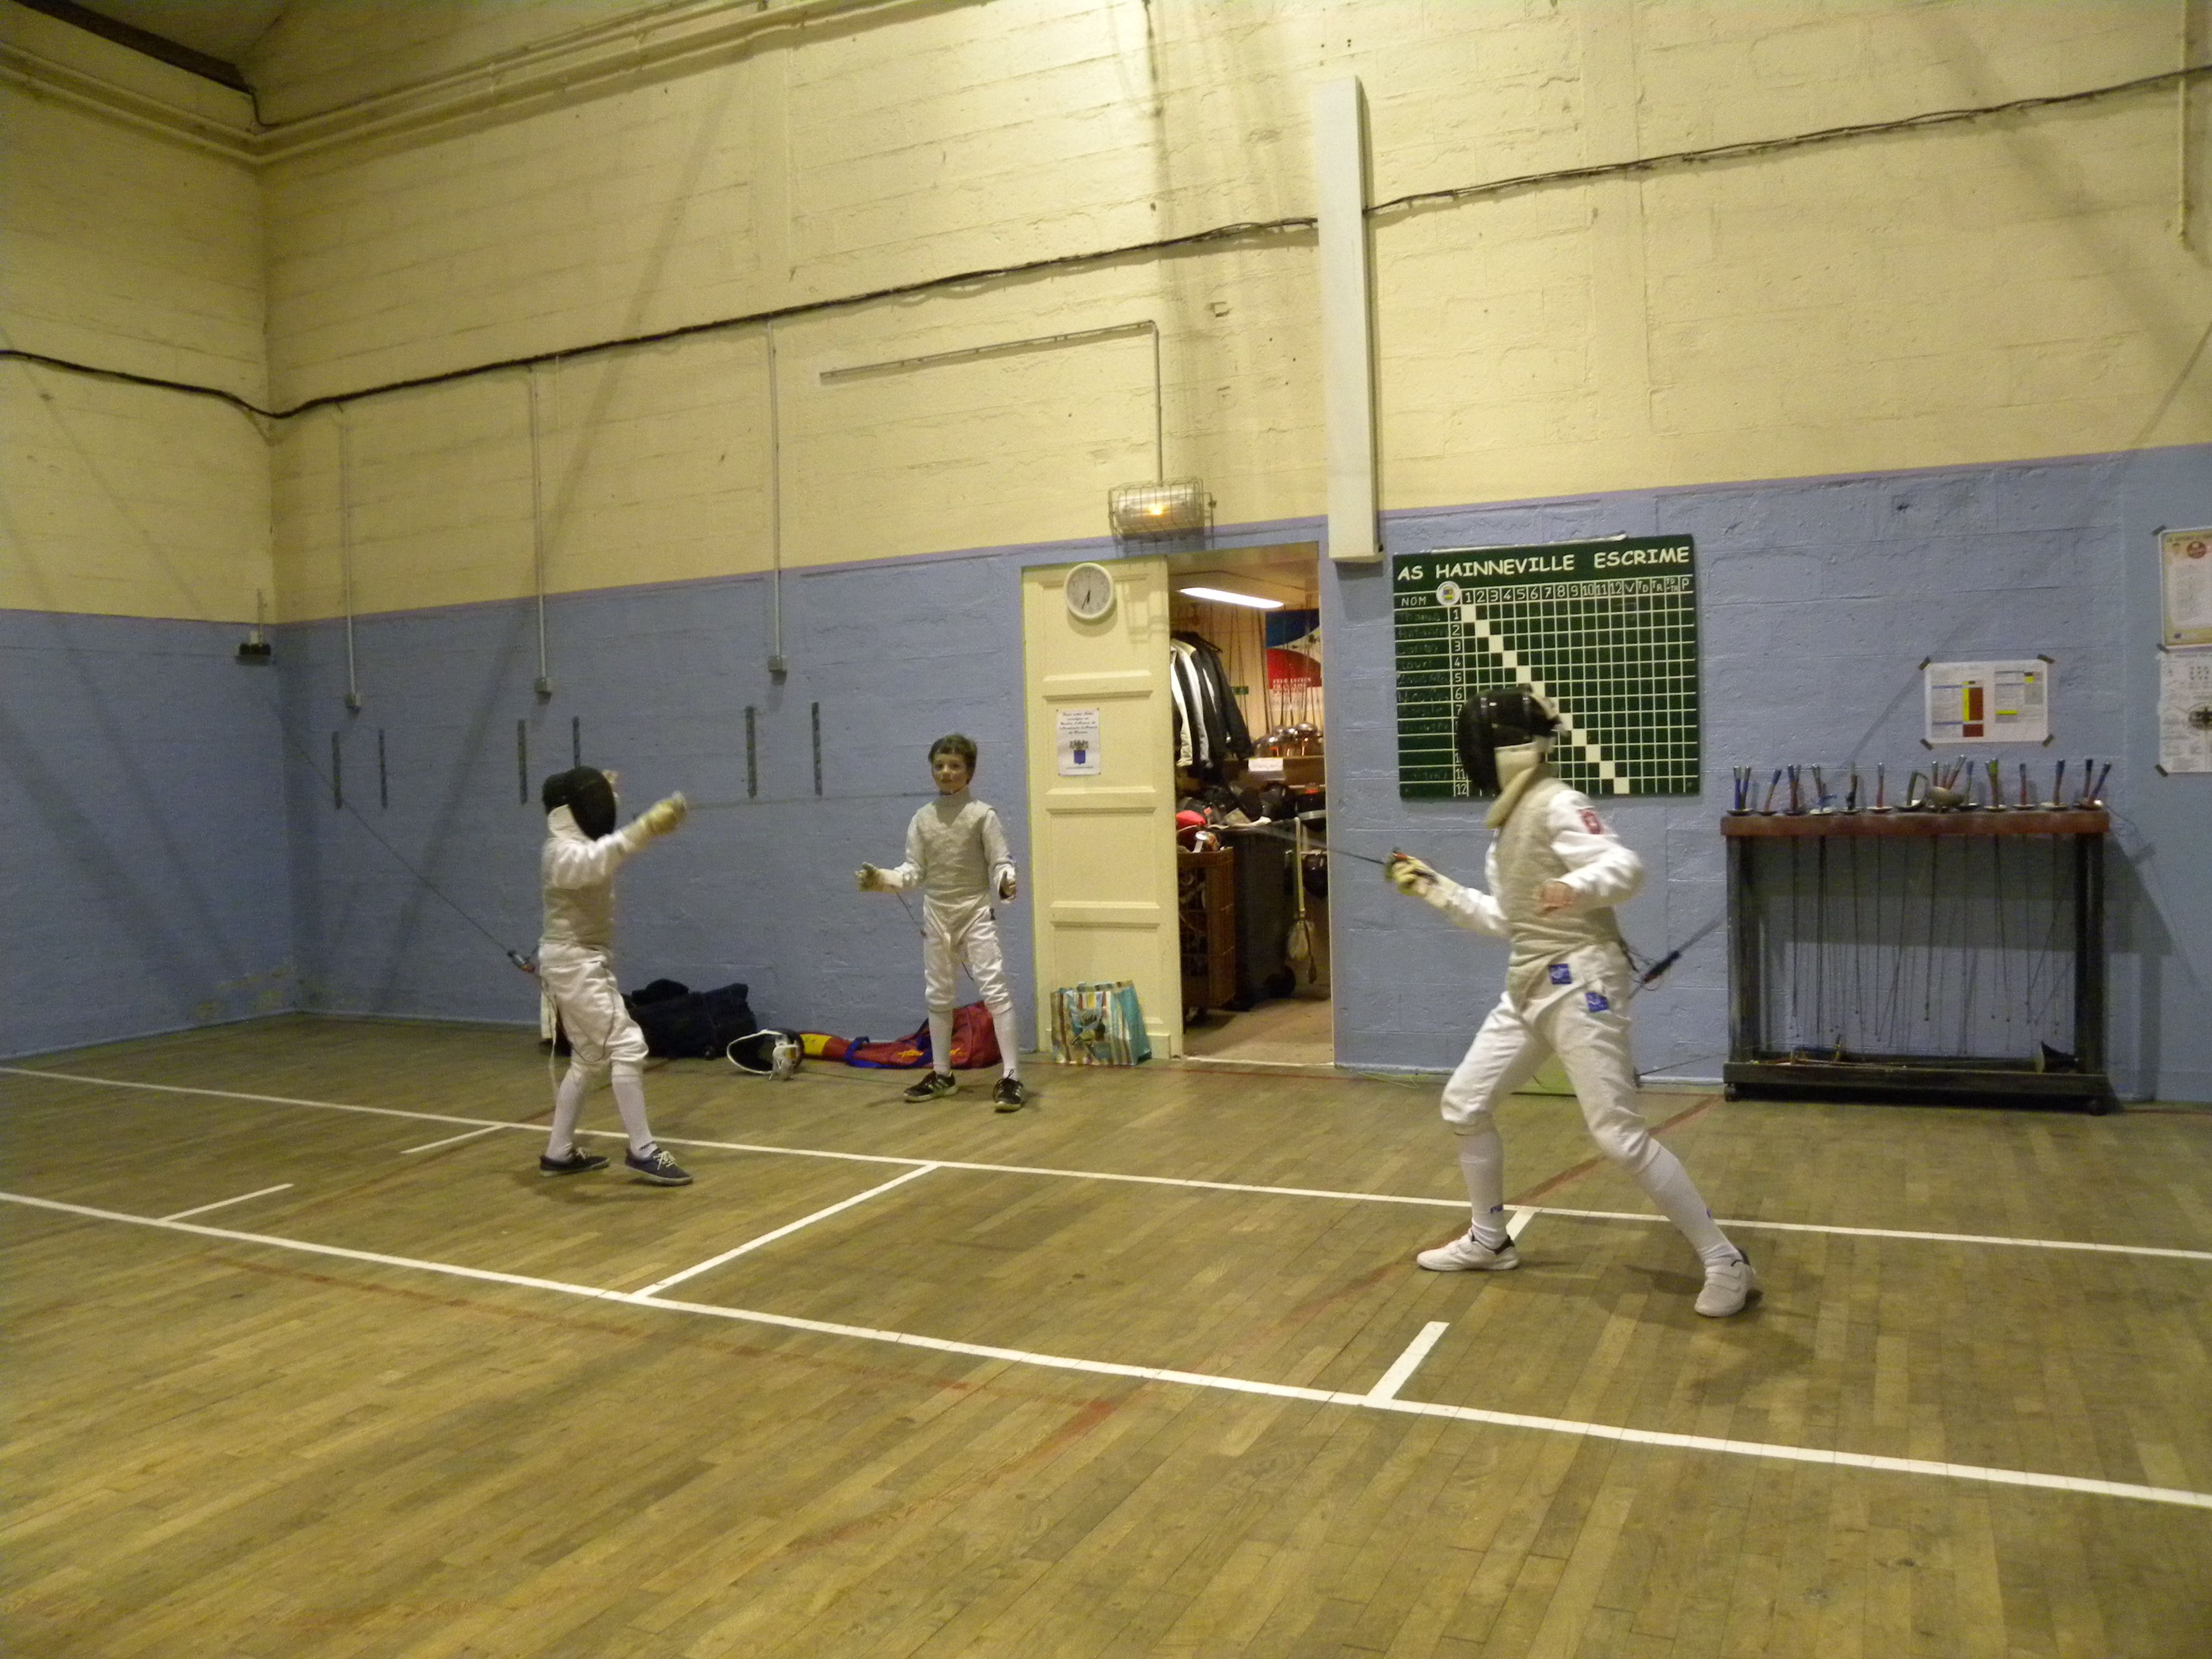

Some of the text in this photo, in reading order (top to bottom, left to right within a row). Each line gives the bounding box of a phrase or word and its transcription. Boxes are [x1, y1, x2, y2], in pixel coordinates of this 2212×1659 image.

[1397, 546, 1690, 581] AS HAINNEVILLE ESCRIME
[1401, 596, 1427, 607] NOM
[1465, 592, 1472, 603] 1
[1476, 591, 1486, 603] 2
[1489, 589, 1499, 602] 3
[1503, 588, 1512, 601] 4
[1516, 588, 1526, 600] 5
[1530, 587, 1539, 599] 6
[1543, 587, 1552, 598] 7
[1557, 585, 1566, 598] 8
[1571, 585, 1579, 597] 9
[1583, 583, 1595, 596] 10
[1596, 583, 1608, 596] 11
[1609, 581, 1623, 595] 12
[1681, 578, 1689, 591] P
[1453, 609, 1459, 620] 1
[1452, 624, 1460, 636] 2
[1454, 640, 1462, 652] 3
[1454, 656, 1462, 667] 4
[1454, 672, 1462, 683] 5
[1454, 687, 1463, 700] 6
[1455, 704, 1463, 715] 7
[1455, 768, 1466, 780] 11
[1455, 783, 1468, 795] 12
